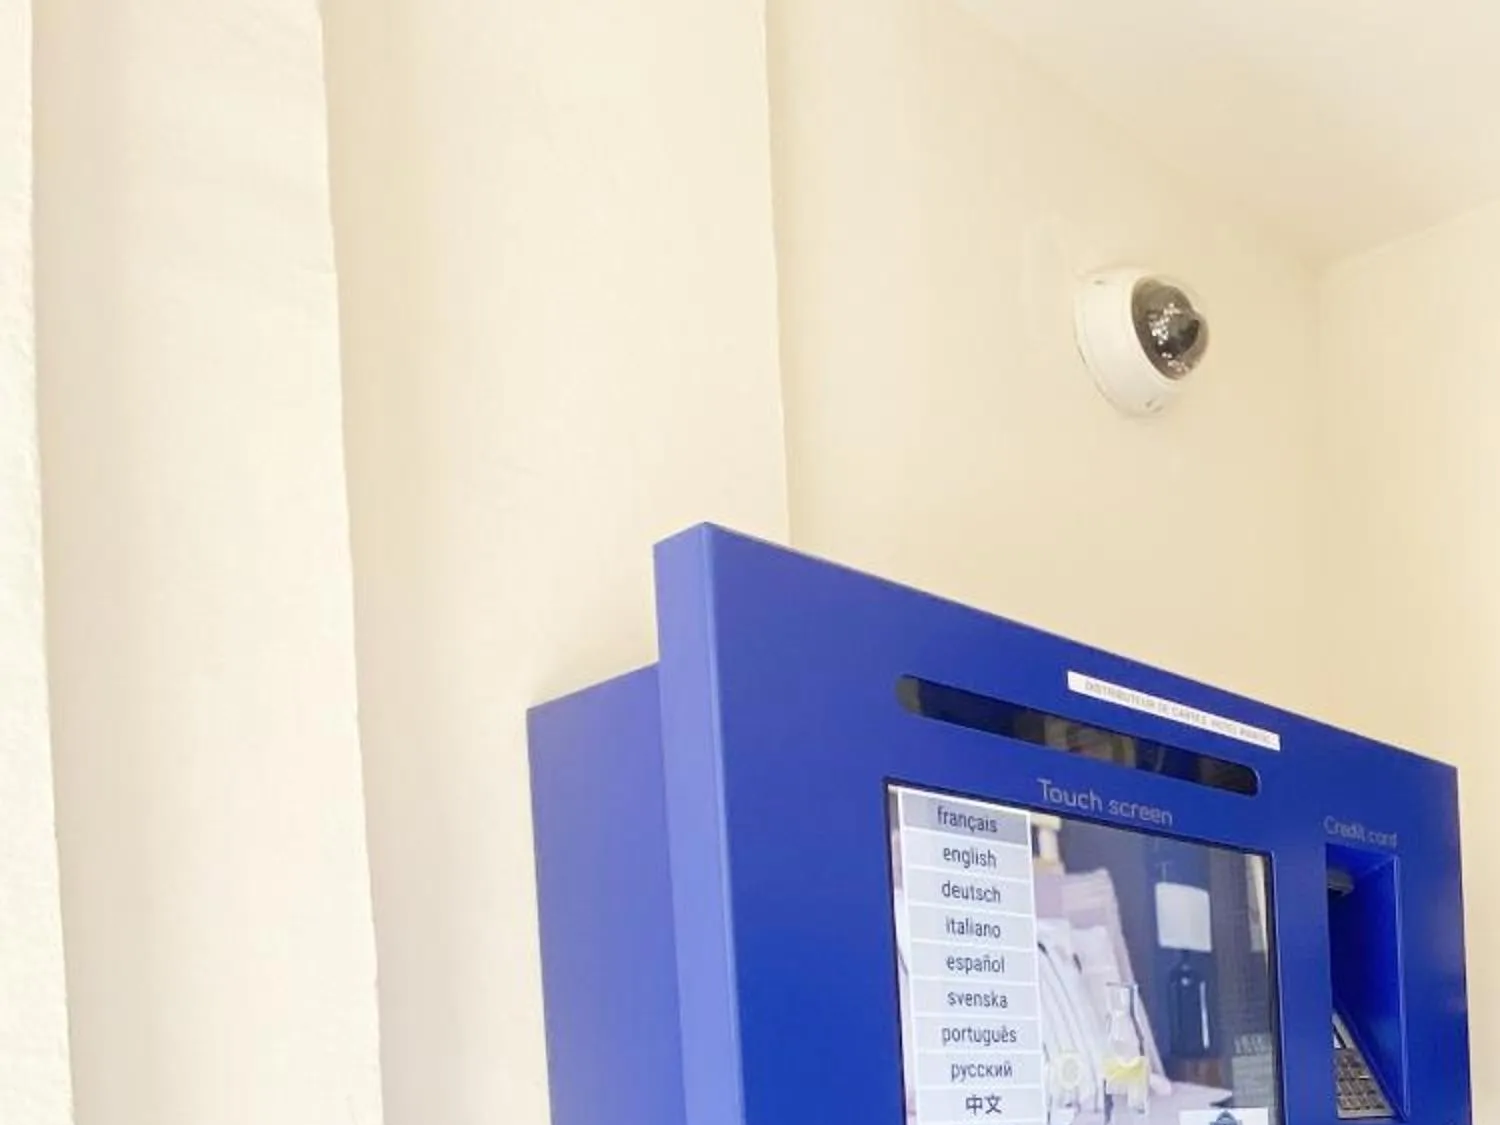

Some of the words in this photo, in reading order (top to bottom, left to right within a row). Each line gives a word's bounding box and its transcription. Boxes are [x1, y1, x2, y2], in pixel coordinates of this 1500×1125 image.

[1036, 778, 1103, 812] Touch
[1108, 799, 1174, 828] screen
[937, 806, 998, 834] français
[1323, 814, 1365, 843] Credit
[943, 847, 998, 869] english
[941, 880, 1001, 904] deutsch
[945, 916, 1001, 939] italiano
[946, 956, 1006, 975] español
[947, 989, 1008, 1009] svenska
[941, 1025, 1018, 1047] português
[951, 1061, 1014, 1083] русский
[965, 1094, 1003, 1116] 中文
